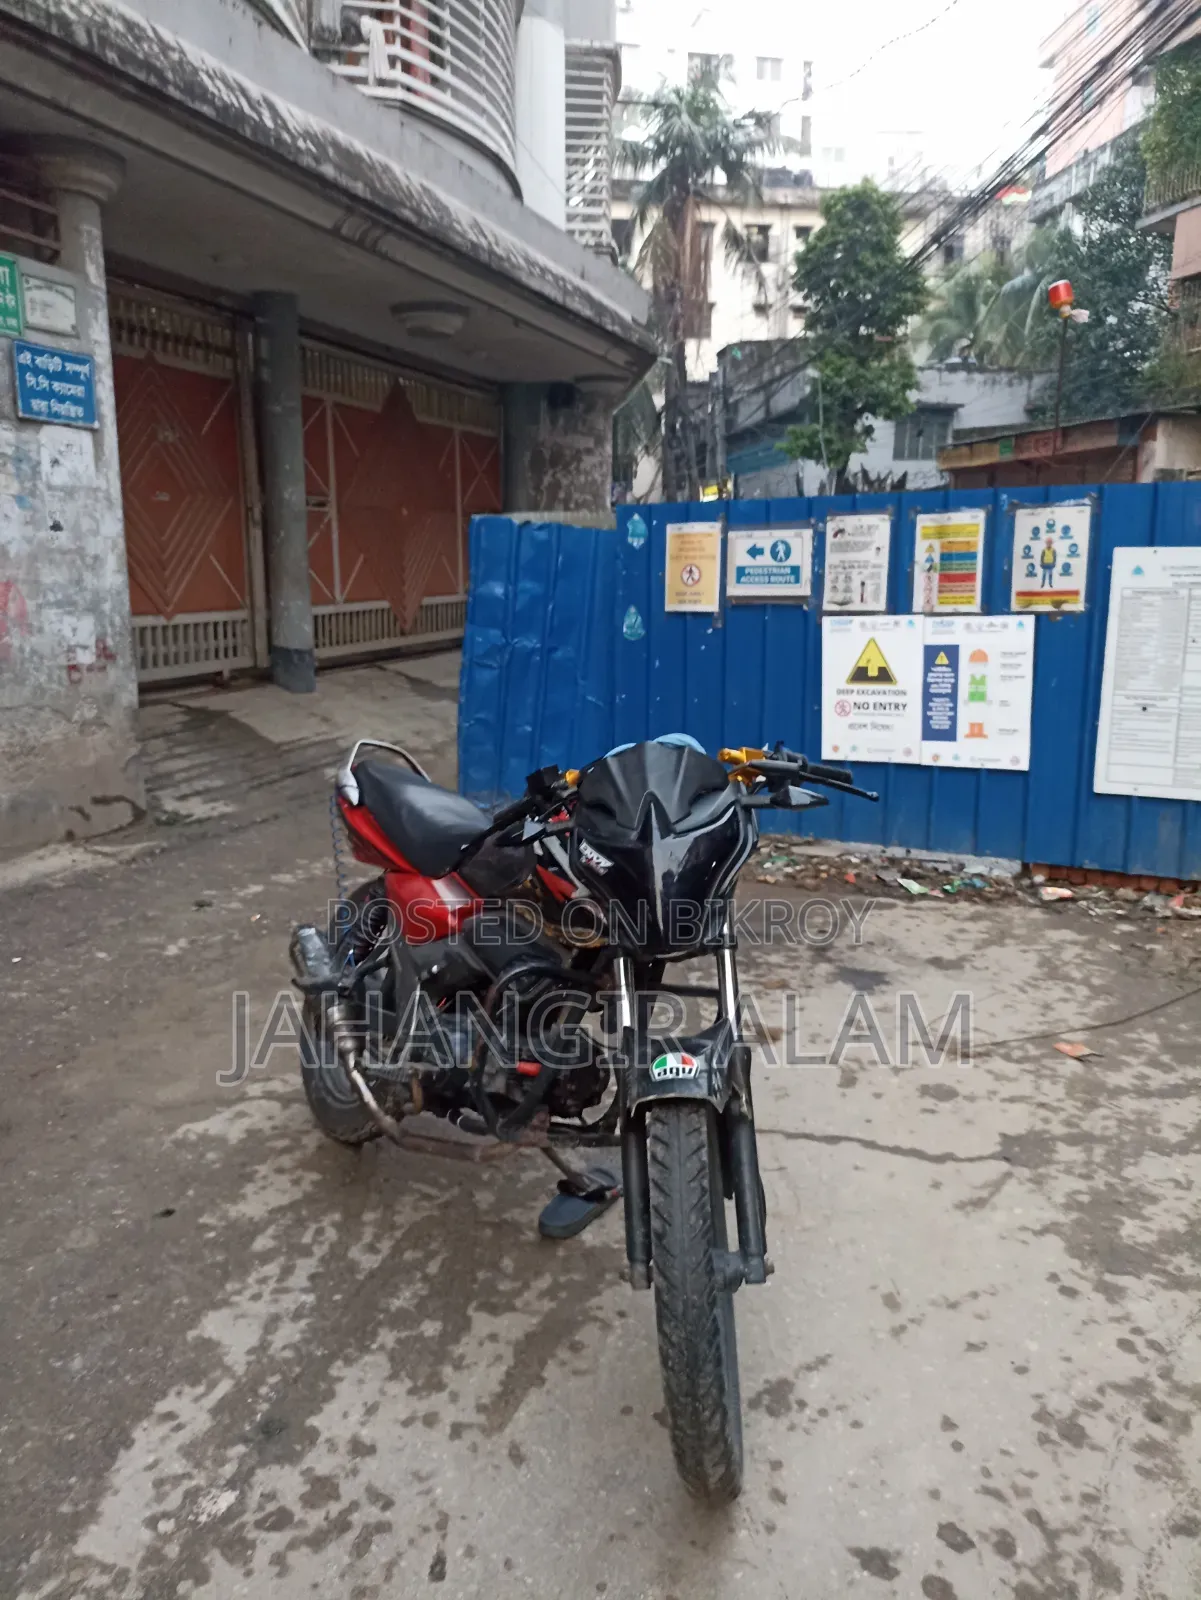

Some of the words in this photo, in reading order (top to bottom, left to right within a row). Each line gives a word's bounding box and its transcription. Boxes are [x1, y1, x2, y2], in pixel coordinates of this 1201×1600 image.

[51, 380, 85, 399] ক্যামেরা
[744, 567, 791, 575] PEDESTRIAN
[740, 575, 769, 584] ACCESS
[770, 575, 796, 584] ROUTE
[836, 688, 854, 696] DEEP
[856, 688, 907, 696] EXCAVATION
[853, 702, 870, 710] NO
[873, 702, 907, 711] ENTRY
